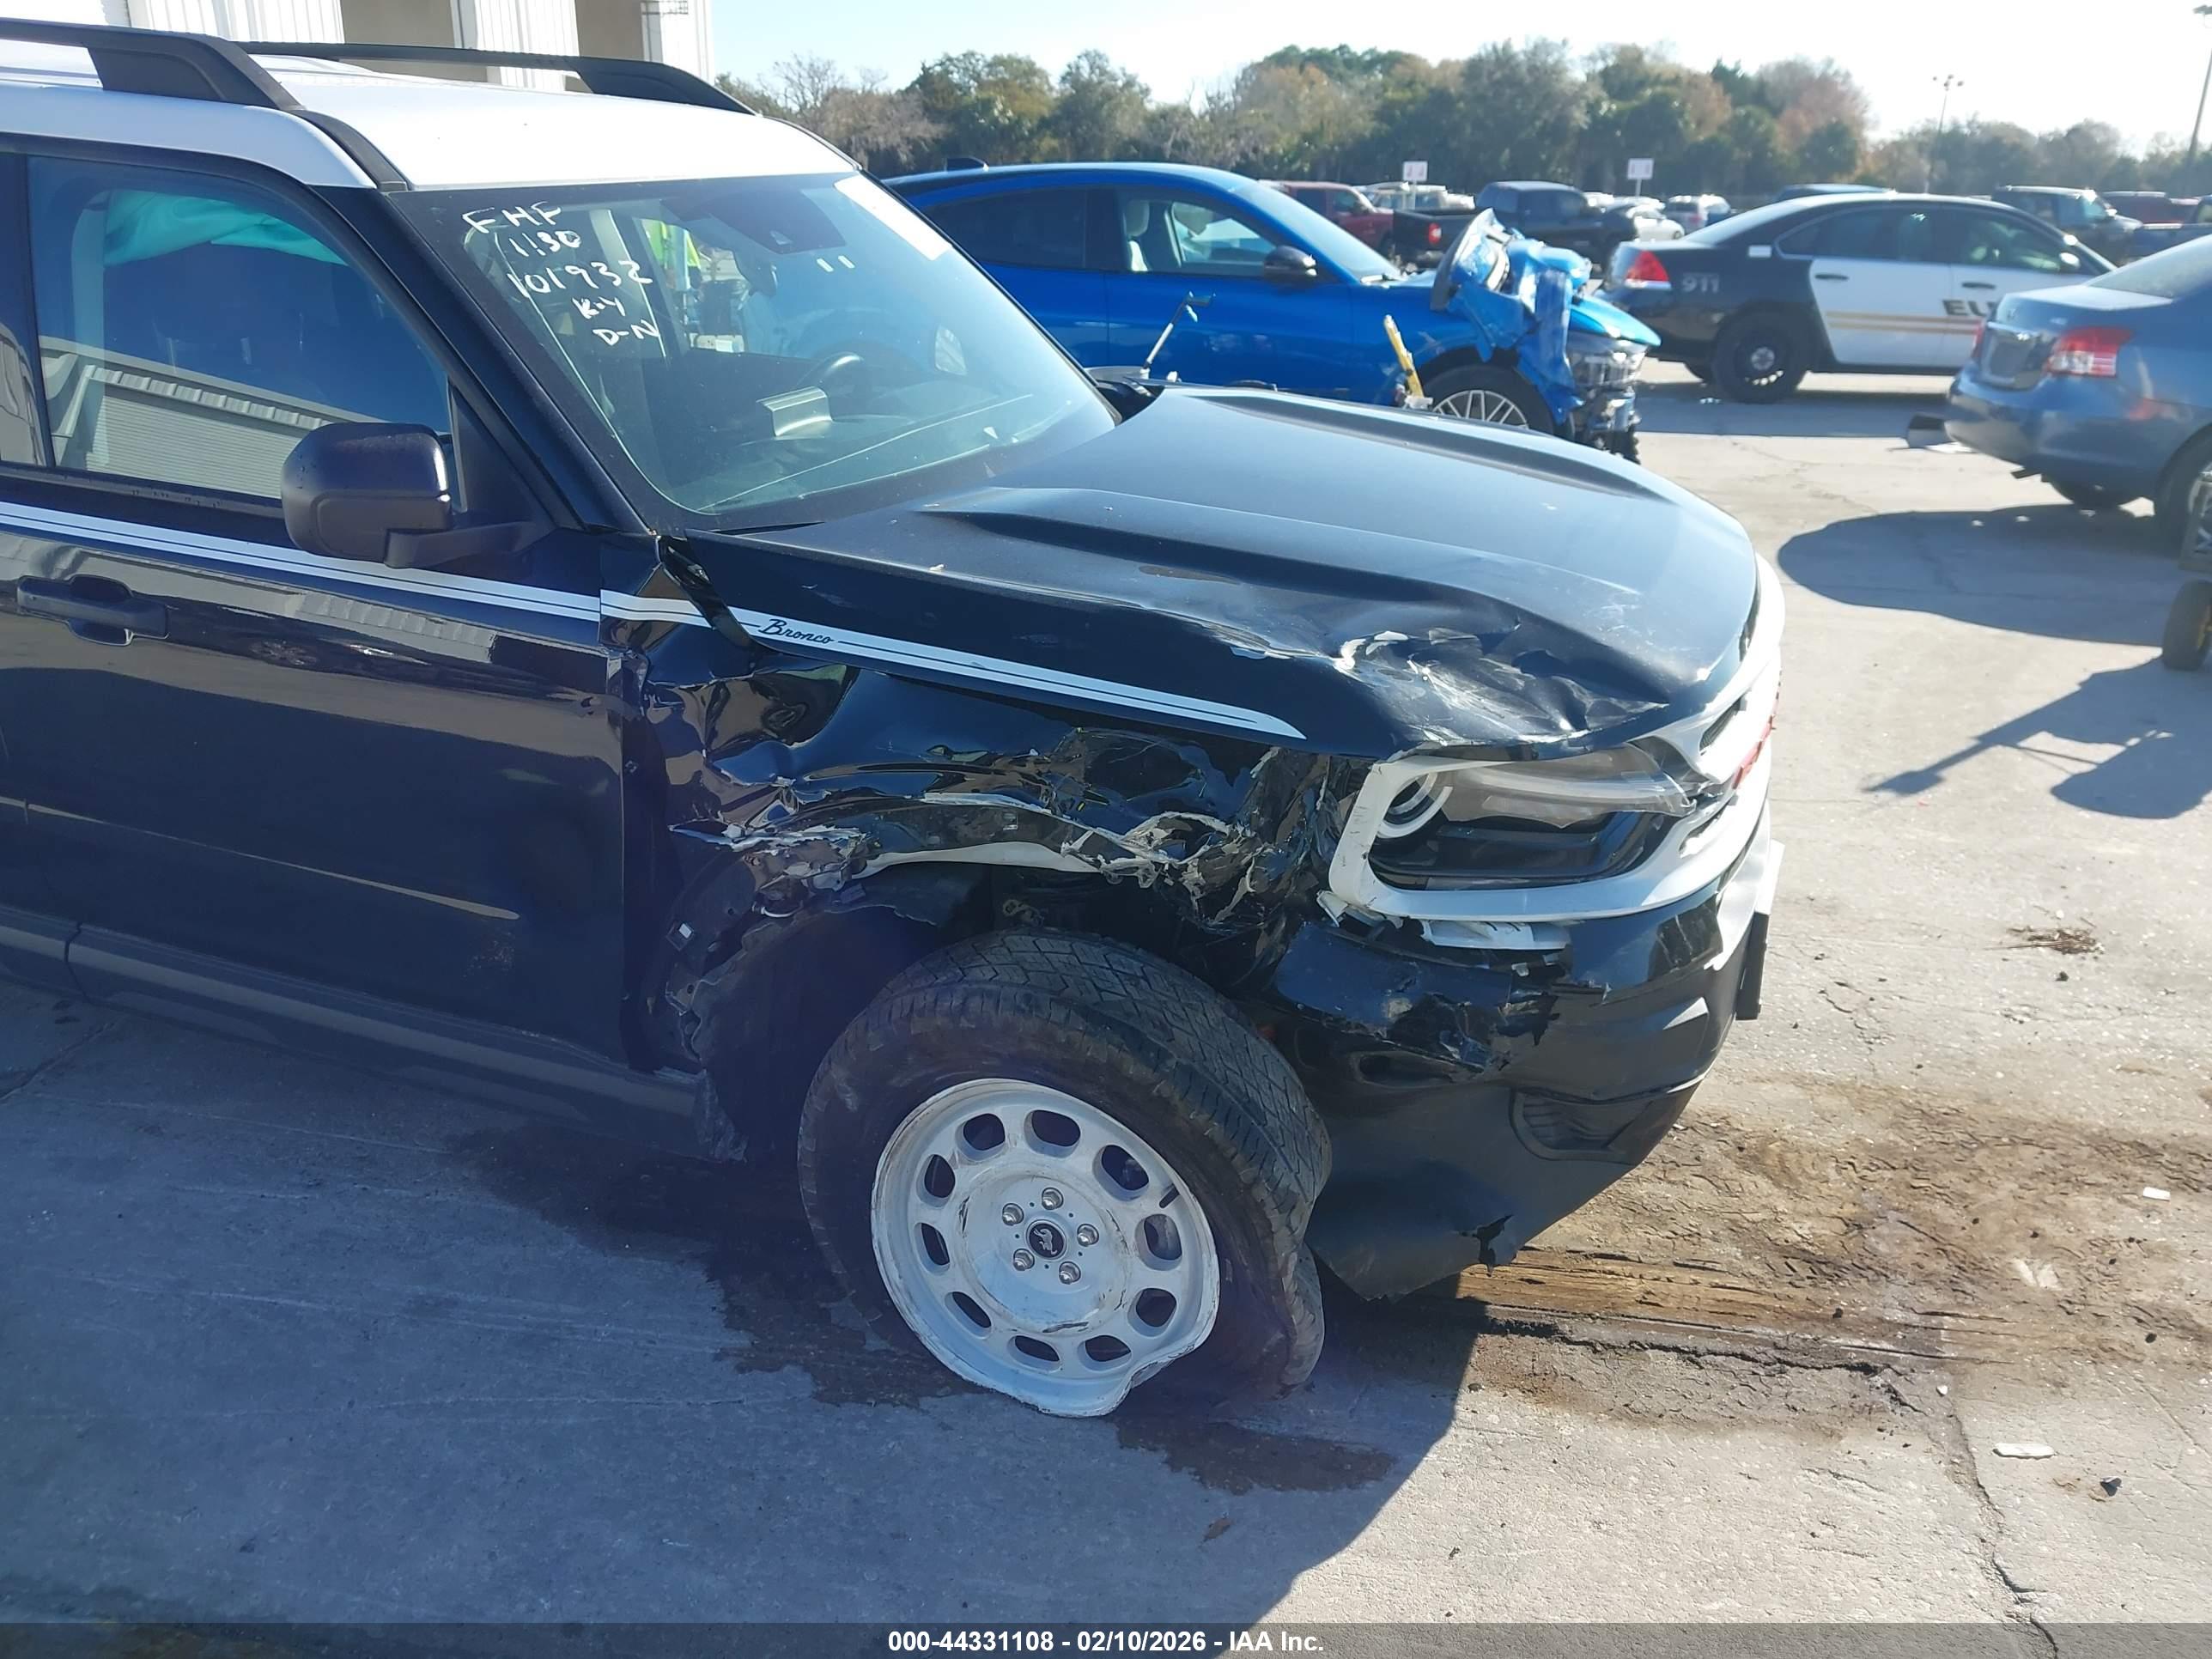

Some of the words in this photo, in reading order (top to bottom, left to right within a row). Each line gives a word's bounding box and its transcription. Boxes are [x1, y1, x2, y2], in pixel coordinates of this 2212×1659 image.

[507, 260, 653, 298] 101932
[1680, 273, 1720, 293] 911
[757, 618, 835, 644] Bronco
